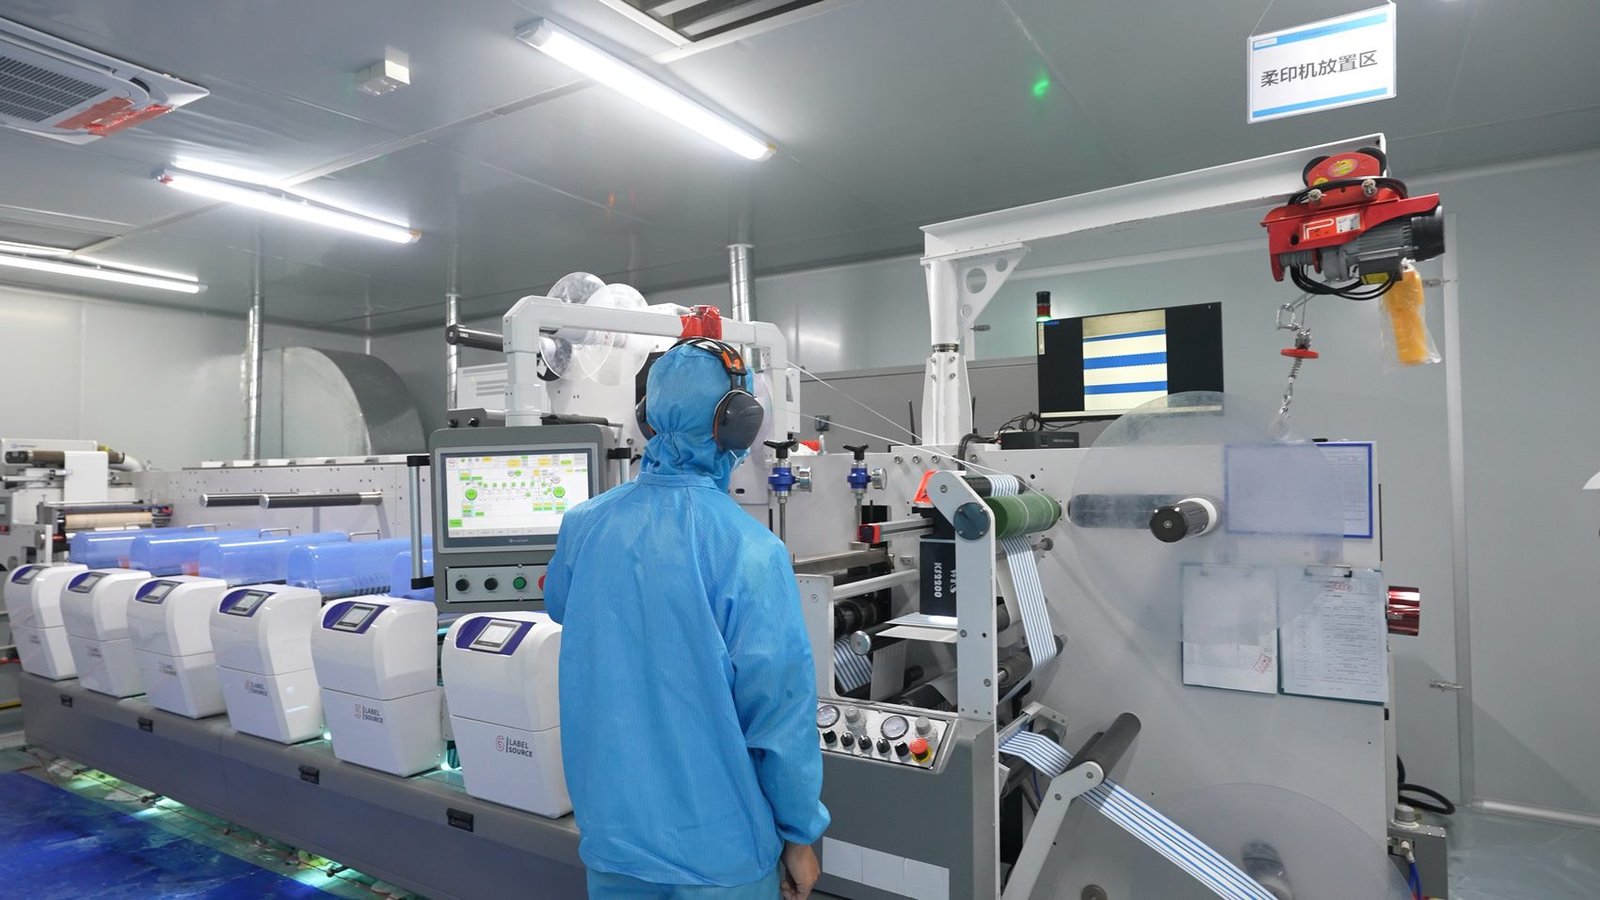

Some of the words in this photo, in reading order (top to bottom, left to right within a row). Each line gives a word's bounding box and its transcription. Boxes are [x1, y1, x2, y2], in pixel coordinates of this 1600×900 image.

[1260, 50, 1378, 88] 柔印机放置区
[365, 706, 380, 716] LABEL
[365, 714, 384, 724] SOURCE
[496, 735, 504, 752] 6
[509, 739, 529, 749] LABEL
[508, 746, 533, 757] SOURCE
